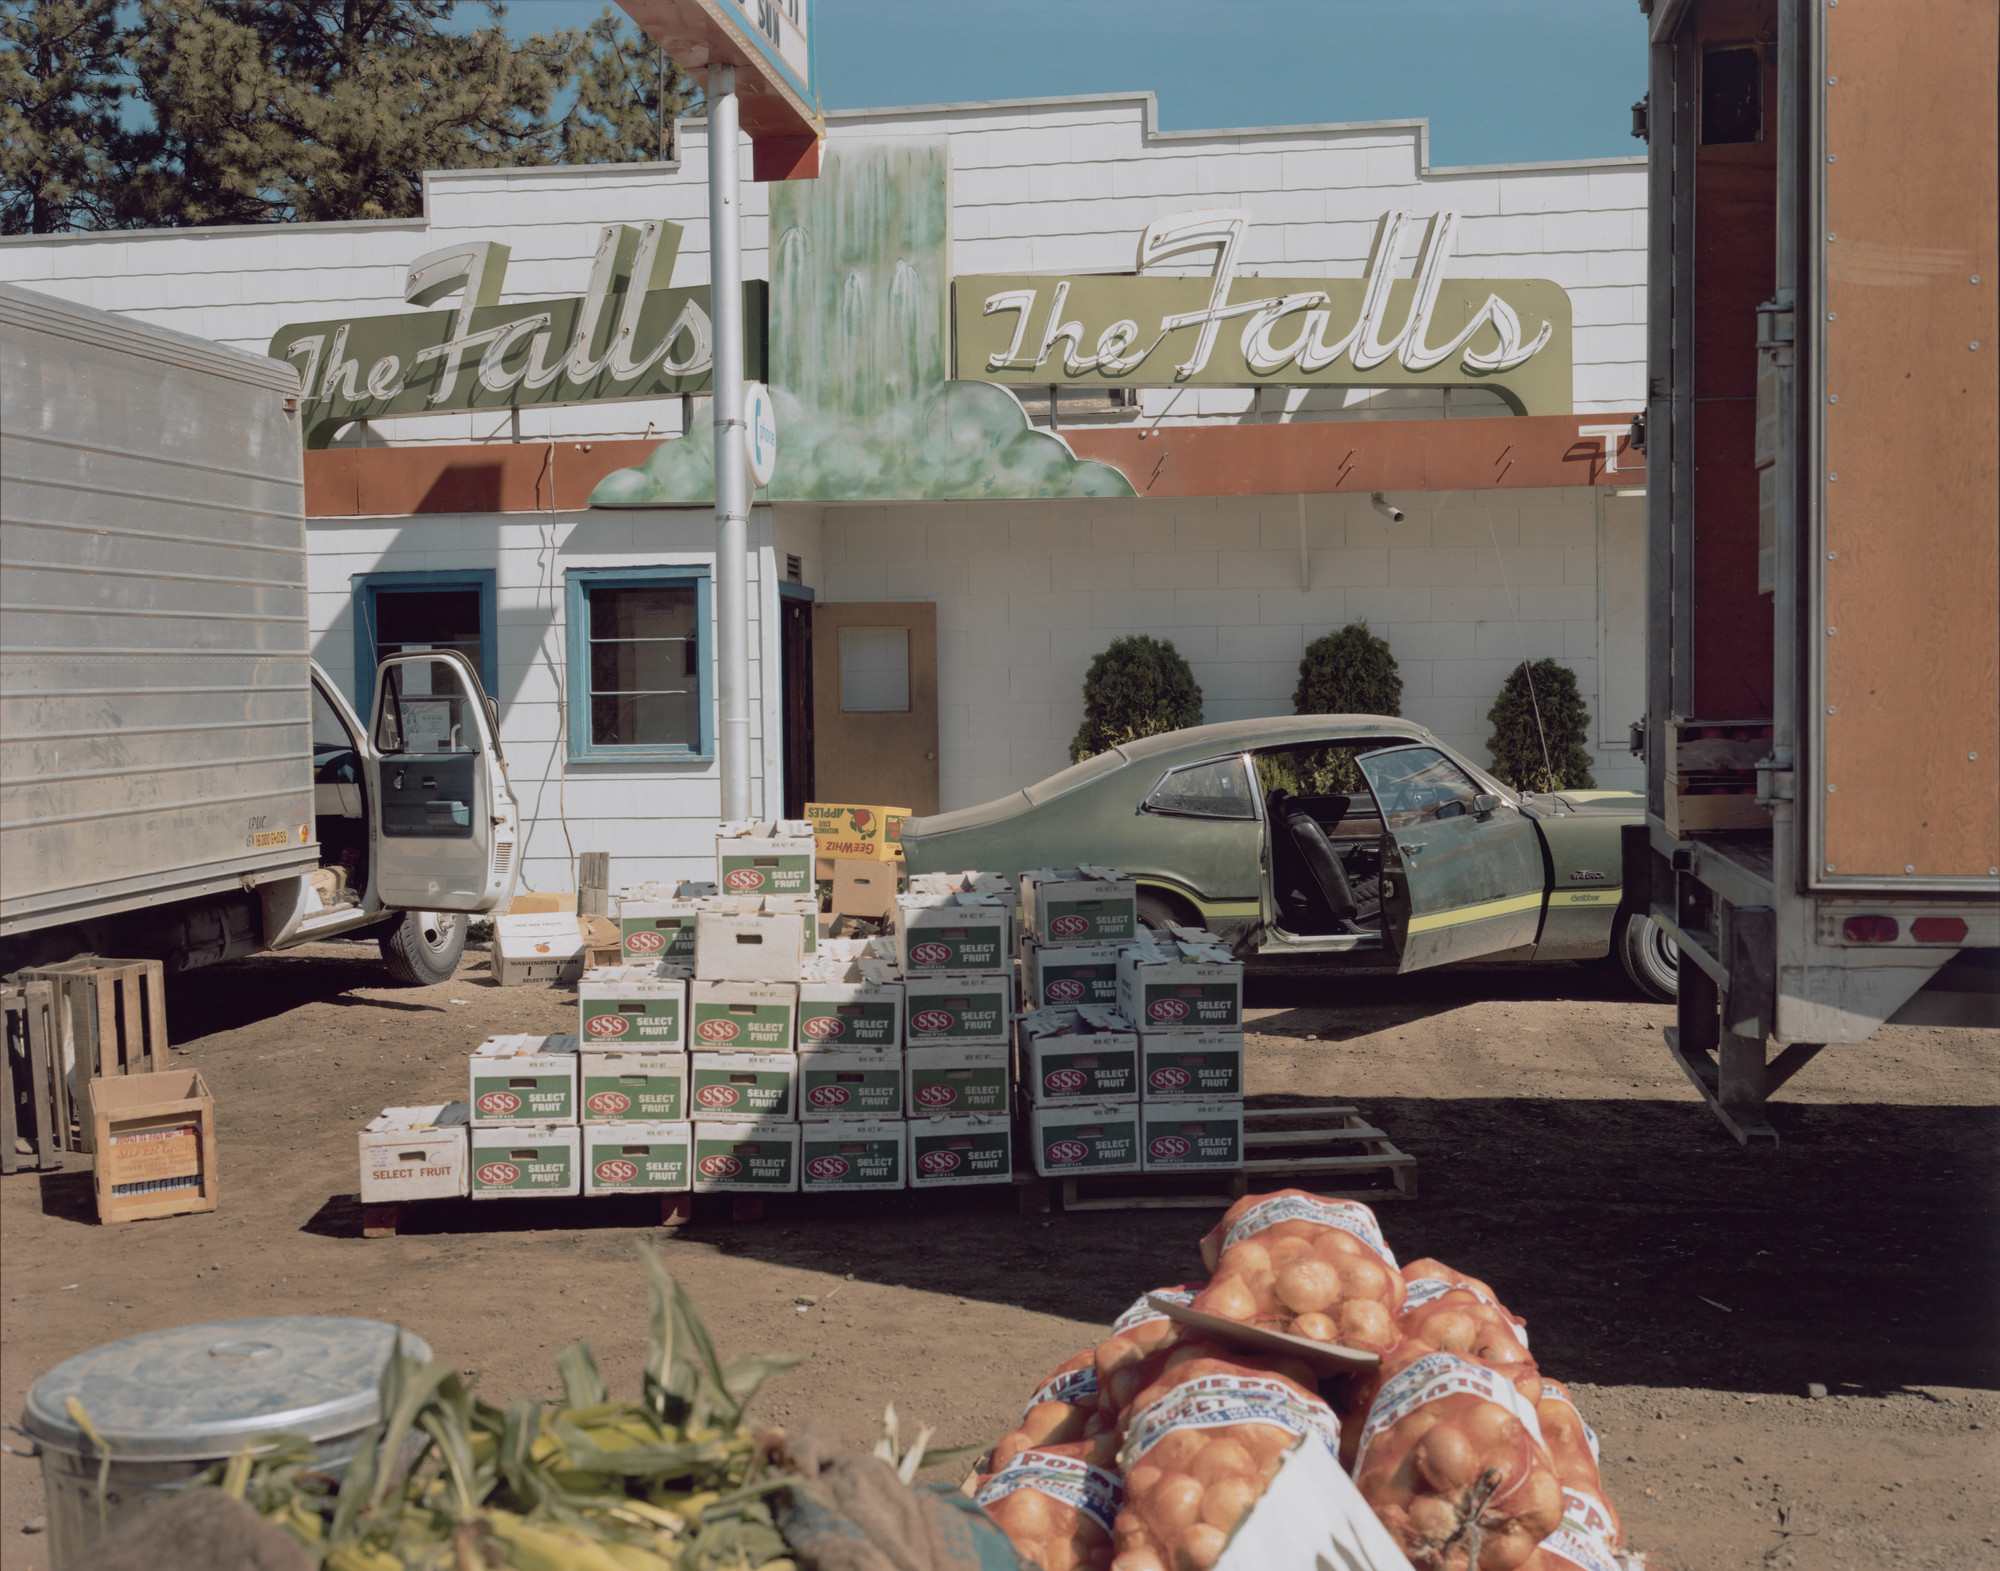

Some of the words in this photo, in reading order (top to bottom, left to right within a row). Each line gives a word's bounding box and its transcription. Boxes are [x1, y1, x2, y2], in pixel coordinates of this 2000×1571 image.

[983, 281, 1146, 368] The
[1139, 208, 1553, 377] Falls
[286, 324, 404, 402] The
[405, 219, 713, 403] Falls
[760, 421, 775, 447] phone
[808, 807, 845, 819] APPLES
[731, 871, 758, 886] SSS
[771, 871, 804, 879] SELECT
[1095, 915, 1128, 924] SELECT
[1056, 917, 1083, 932] SSS
[1099, 924, 1124, 932] FRUIT
[672, 931, 694, 940] SELE
[631, 933, 659, 949] SSS
[675, 941, 694, 949] FRU
[916, 944, 945, 960] SSS
[959, 944, 995, 953] SELECT
[963, 953, 990, 962] FRUIT
[1091, 979, 1116, 988] SELE
[1051, 981, 1079, 996] SSS
[1095, 988, 1116, 997] FRUI
[1154, 1001, 1183, 1016] SSS
[1196, 1001, 1231, 1009] SELECT
[961, 1011, 996, 1020] SELECT
[1200, 1010, 1227, 1018] FRUIT
[636, 1017, 672, 1025] SELECT
[853, 1019, 889, 1028] SELECT
[918, 1012, 947, 1028] SSS
[964, 1020, 992, 1029] FRUIT
[592, 1017, 622, 1033] SSS
[703, 1021, 733, 1038] SSS
[747, 1022, 783, 1032] SELECT
[809, 1018, 839, 1035] SSS
[750, 1032, 778, 1041] FRUIT
[856, 1029, 884, 1038] FRUIT
[1094, 1068, 1129, 1078] SELECT
[1155, 1069, 1184, 1085] SSS
[1198, 1069, 1233, 1077] SELECT
[1051, 1071, 1080, 1088] SSS
[1098, 1078, 1125, 1087] FRUIT
[1201, 1078, 1228, 1086] FRUIT
[747, 1088, 783, 1098] SELECT
[858, 1087, 893, 1096] SELECT
[921, 1086, 950, 1102] SSS
[964, 1085, 1000, 1094] SELECT
[528, 1092, 565, 1102] SELECT
[638, 1094, 675, 1103] SELECT
[703, 1086, 733, 1103] SSS
[814, 1087, 844, 1103] SSS
[483, 1093, 514, 1110] SSS
[594, 1094, 624, 1110] SSS
[750, 1098, 778, 1107] FRUIT
[861, 1097, 889, 1105] FRUIT
[968, 1095, 995, 1104] FRUIT
[532, 1102, 561, 1111] FRUIT
[641, 1104, 670, 1112] FRUIT
[1094, 1139, 1130, 1149] SELECT
[1155, 1138, 1184, 1154] SSS
[1197, 1137, 1232, 1146] SELECT
[967, 1150, 1003, 1160] SELECT
[1052, 1142, 1081, 1159] SSS
[1098, 1149, 1126, 1158] FRUIT
[1201, 1147, 1228, 1155] FRUIT
[705, 1157, 735, 1173] SSS
[749, 1158, 785, 1167] SELECT
[857, 1157, 892, 1166] SELECT
[924, 1152, 954, 1169] SSS
[971, 1159, 999, 1169] FRUIT
[528, 1163, 564, 1172] SELECT
[601, 1162, 631, 1178] SSS
[645, 1162, 681, 1170] SELECT
[814, 1158, 843, 1174] SSS
[372, 1169, 414, 1181] SELECT
[420, 1166, 452, 1177] FRUIT
[483, 1164, 513, 1180] SSS
[649, 1172, 677, 1180] FRUIT
[752, 1168, 780, 1176] FRUIT
[860, 1167, 888, 1176] FRUIT
[531, 1173, 560, 1182] FRUIT
